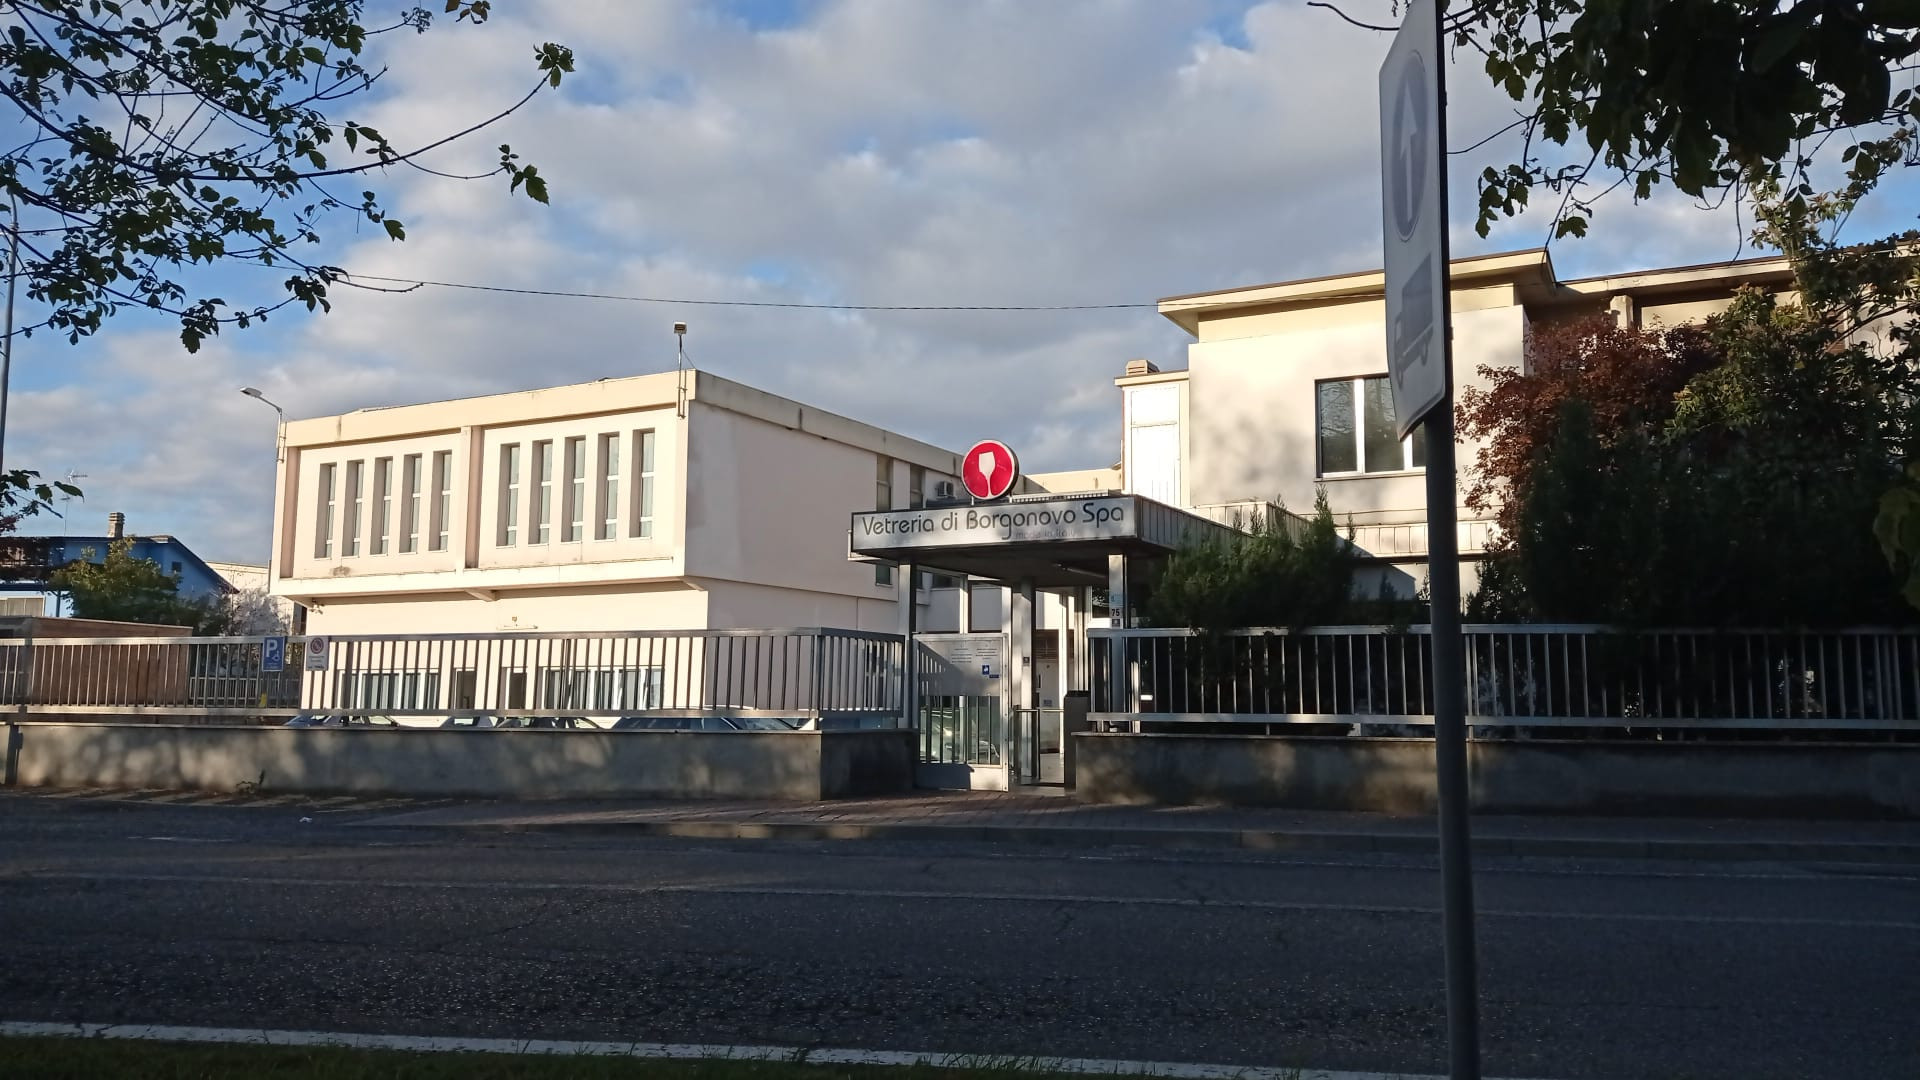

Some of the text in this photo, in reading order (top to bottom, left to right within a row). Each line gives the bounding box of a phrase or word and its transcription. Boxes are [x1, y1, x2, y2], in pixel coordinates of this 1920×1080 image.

[862, 503, 1124, 540] Vetreria di Borgonovo Spa
[1111, 608, 1120, 617] 75
[266, 639, 278, 658] P
